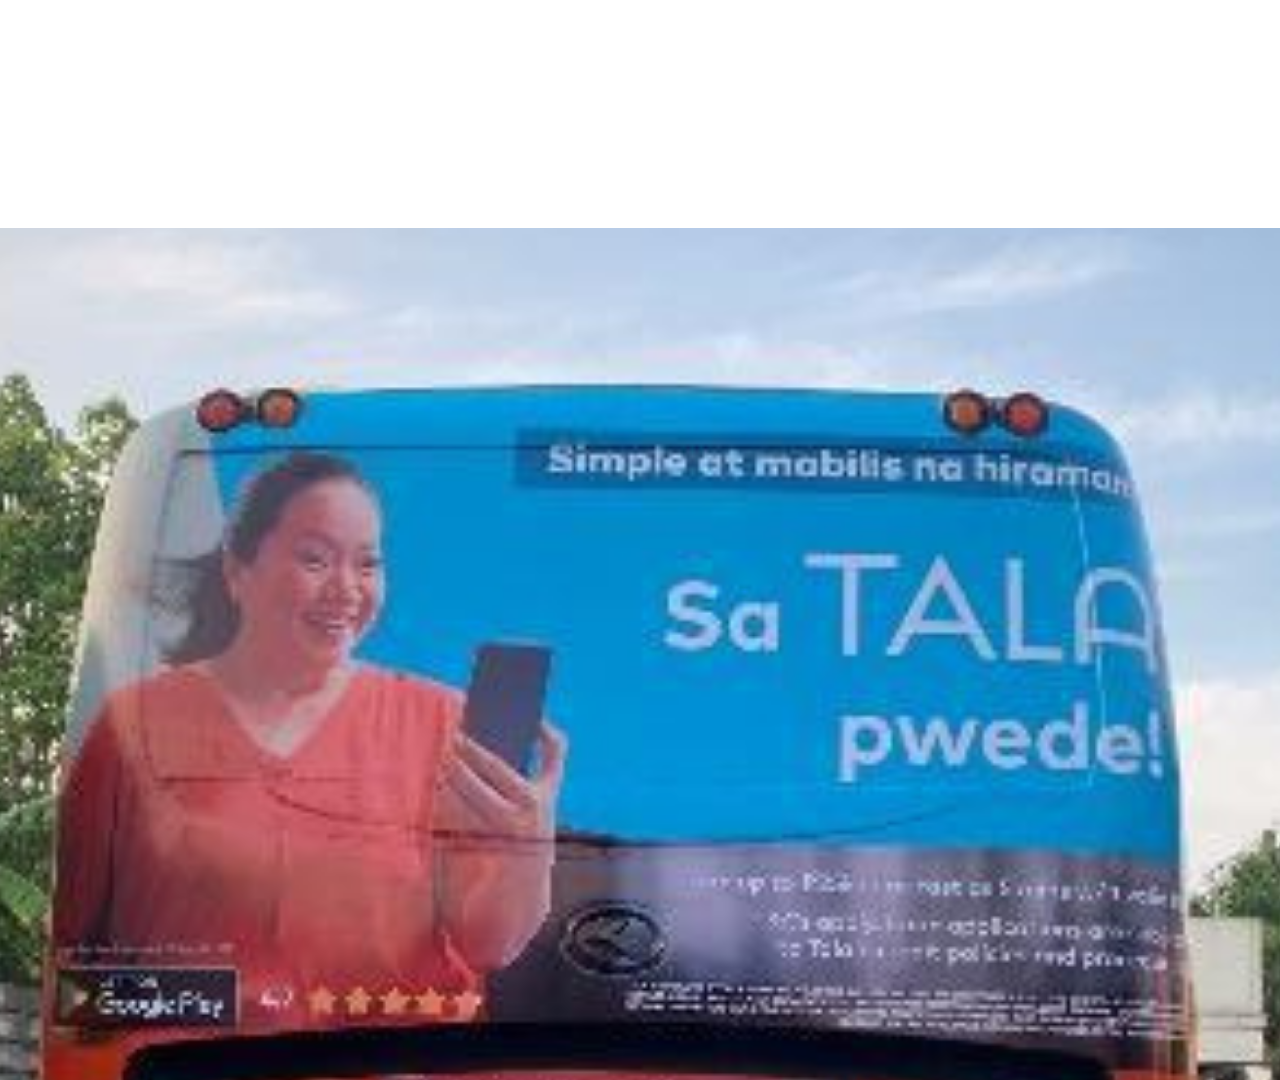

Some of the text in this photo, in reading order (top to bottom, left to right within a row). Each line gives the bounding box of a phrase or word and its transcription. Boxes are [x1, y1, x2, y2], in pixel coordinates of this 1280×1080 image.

[547, 443, 687, 481] Simple
[698, 446, 745, 478] at
[754, 447, 904, 481] mabilis
[913, 456, 964, 482] na
[663, 552, 1159, 674] Sa TALA
[838, 704, 1165, 783] pwede!
